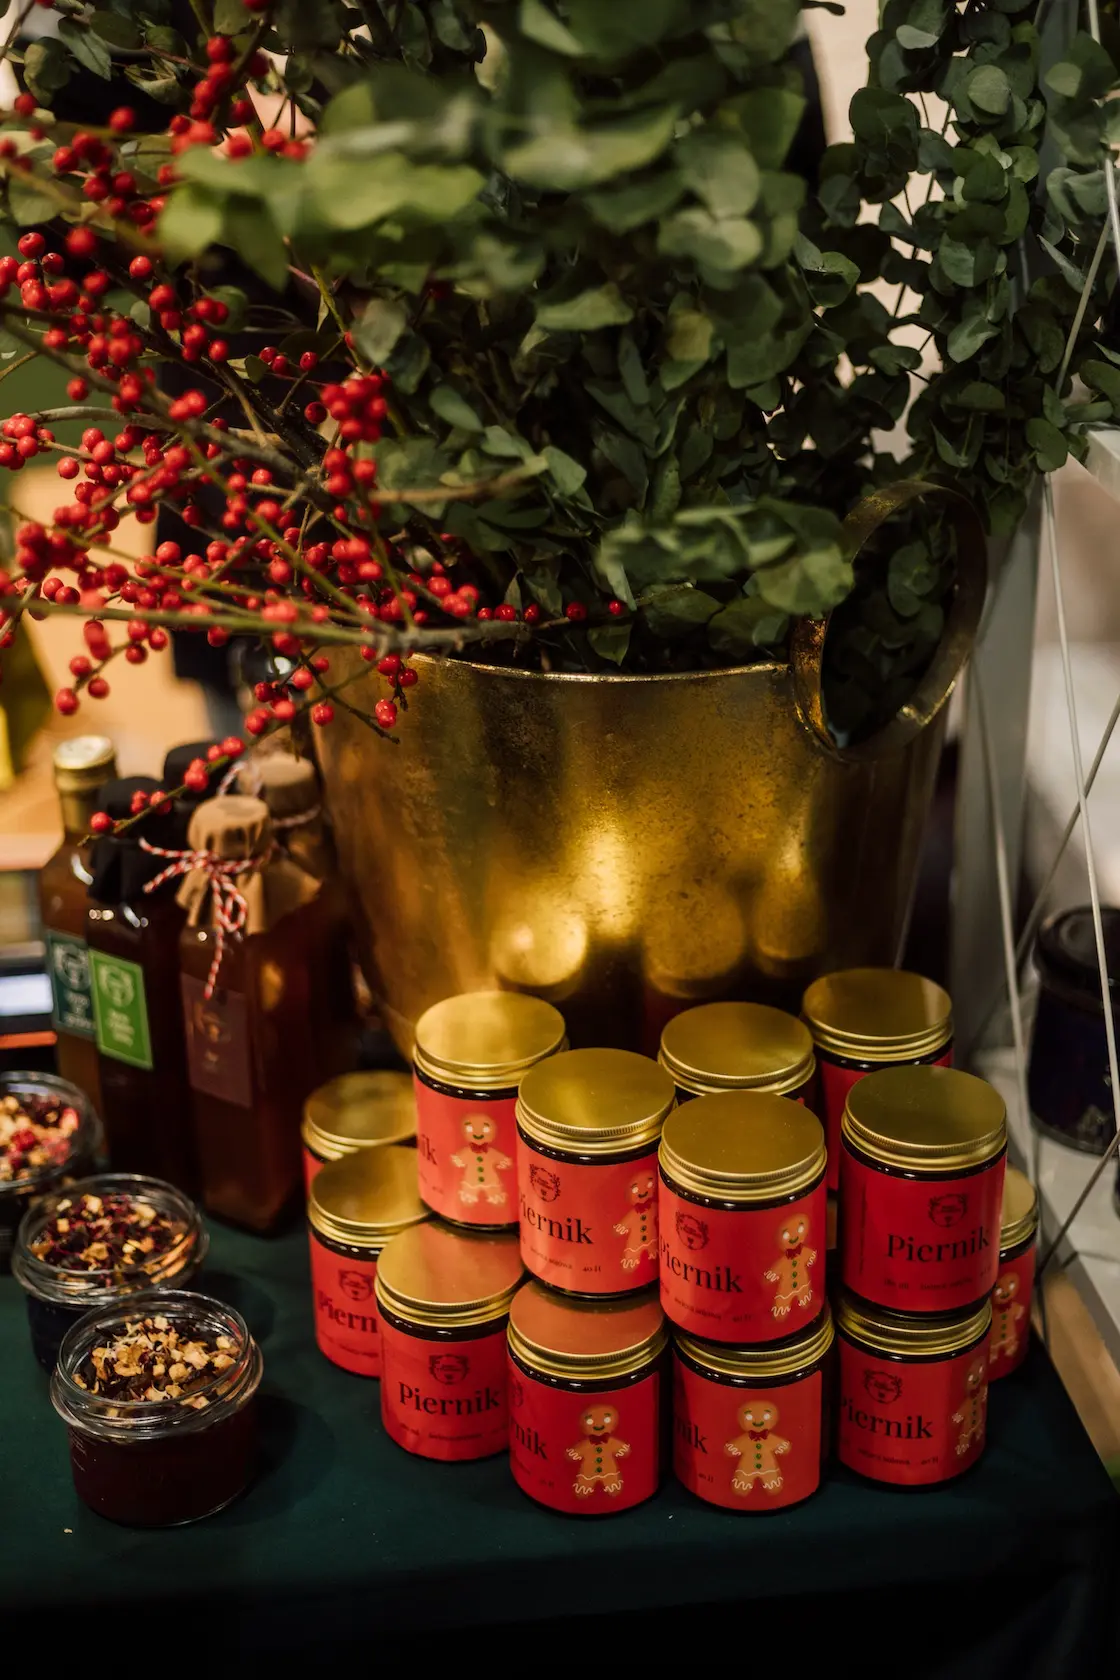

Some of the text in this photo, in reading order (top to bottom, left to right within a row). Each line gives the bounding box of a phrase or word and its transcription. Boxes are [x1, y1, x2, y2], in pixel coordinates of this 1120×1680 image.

[520, 1193, 594, 1245] iernik
[887, 1226, 990, 1263] Piernik
[398, 1381, 501, 1415] Piernik
